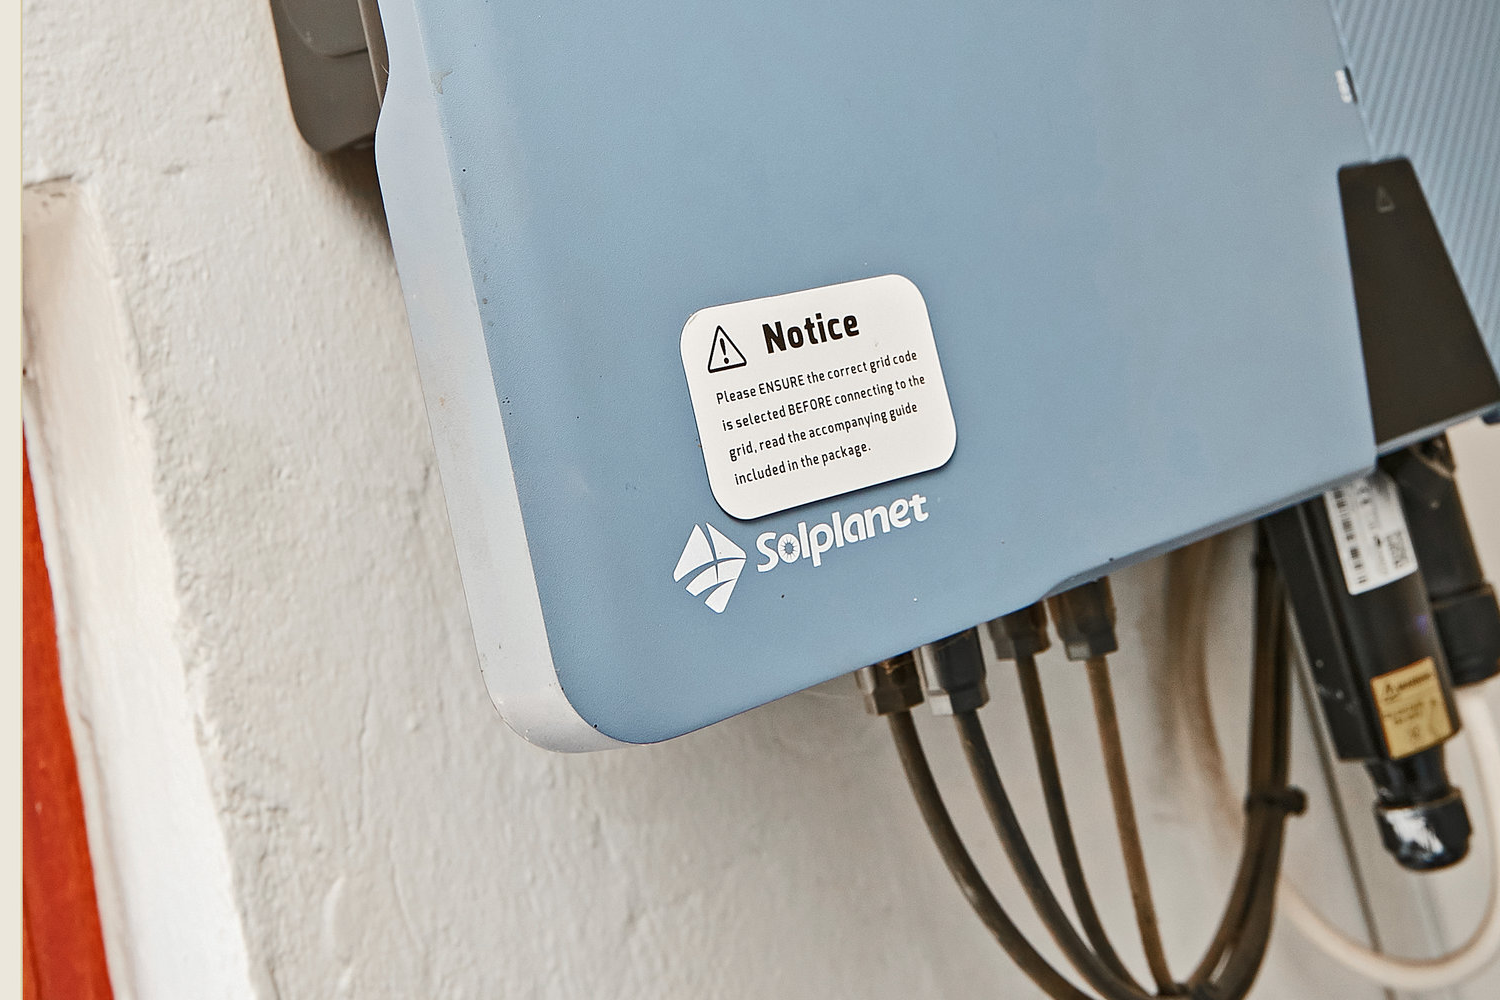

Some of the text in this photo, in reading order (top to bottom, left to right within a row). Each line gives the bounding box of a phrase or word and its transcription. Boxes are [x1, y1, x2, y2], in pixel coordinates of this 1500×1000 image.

[762, 312, 860, 354] Notice
[716, 350, 918, 405] Please ENSURE the correct grid code
[722, 375, 926, 432] is selected BEFORE connecting to the
[729, 402, 918, 462] grid, read the accompanying guide
[734, 443, 872, 485] included in the package.
[755, 493, 930, 573] Solplanet
